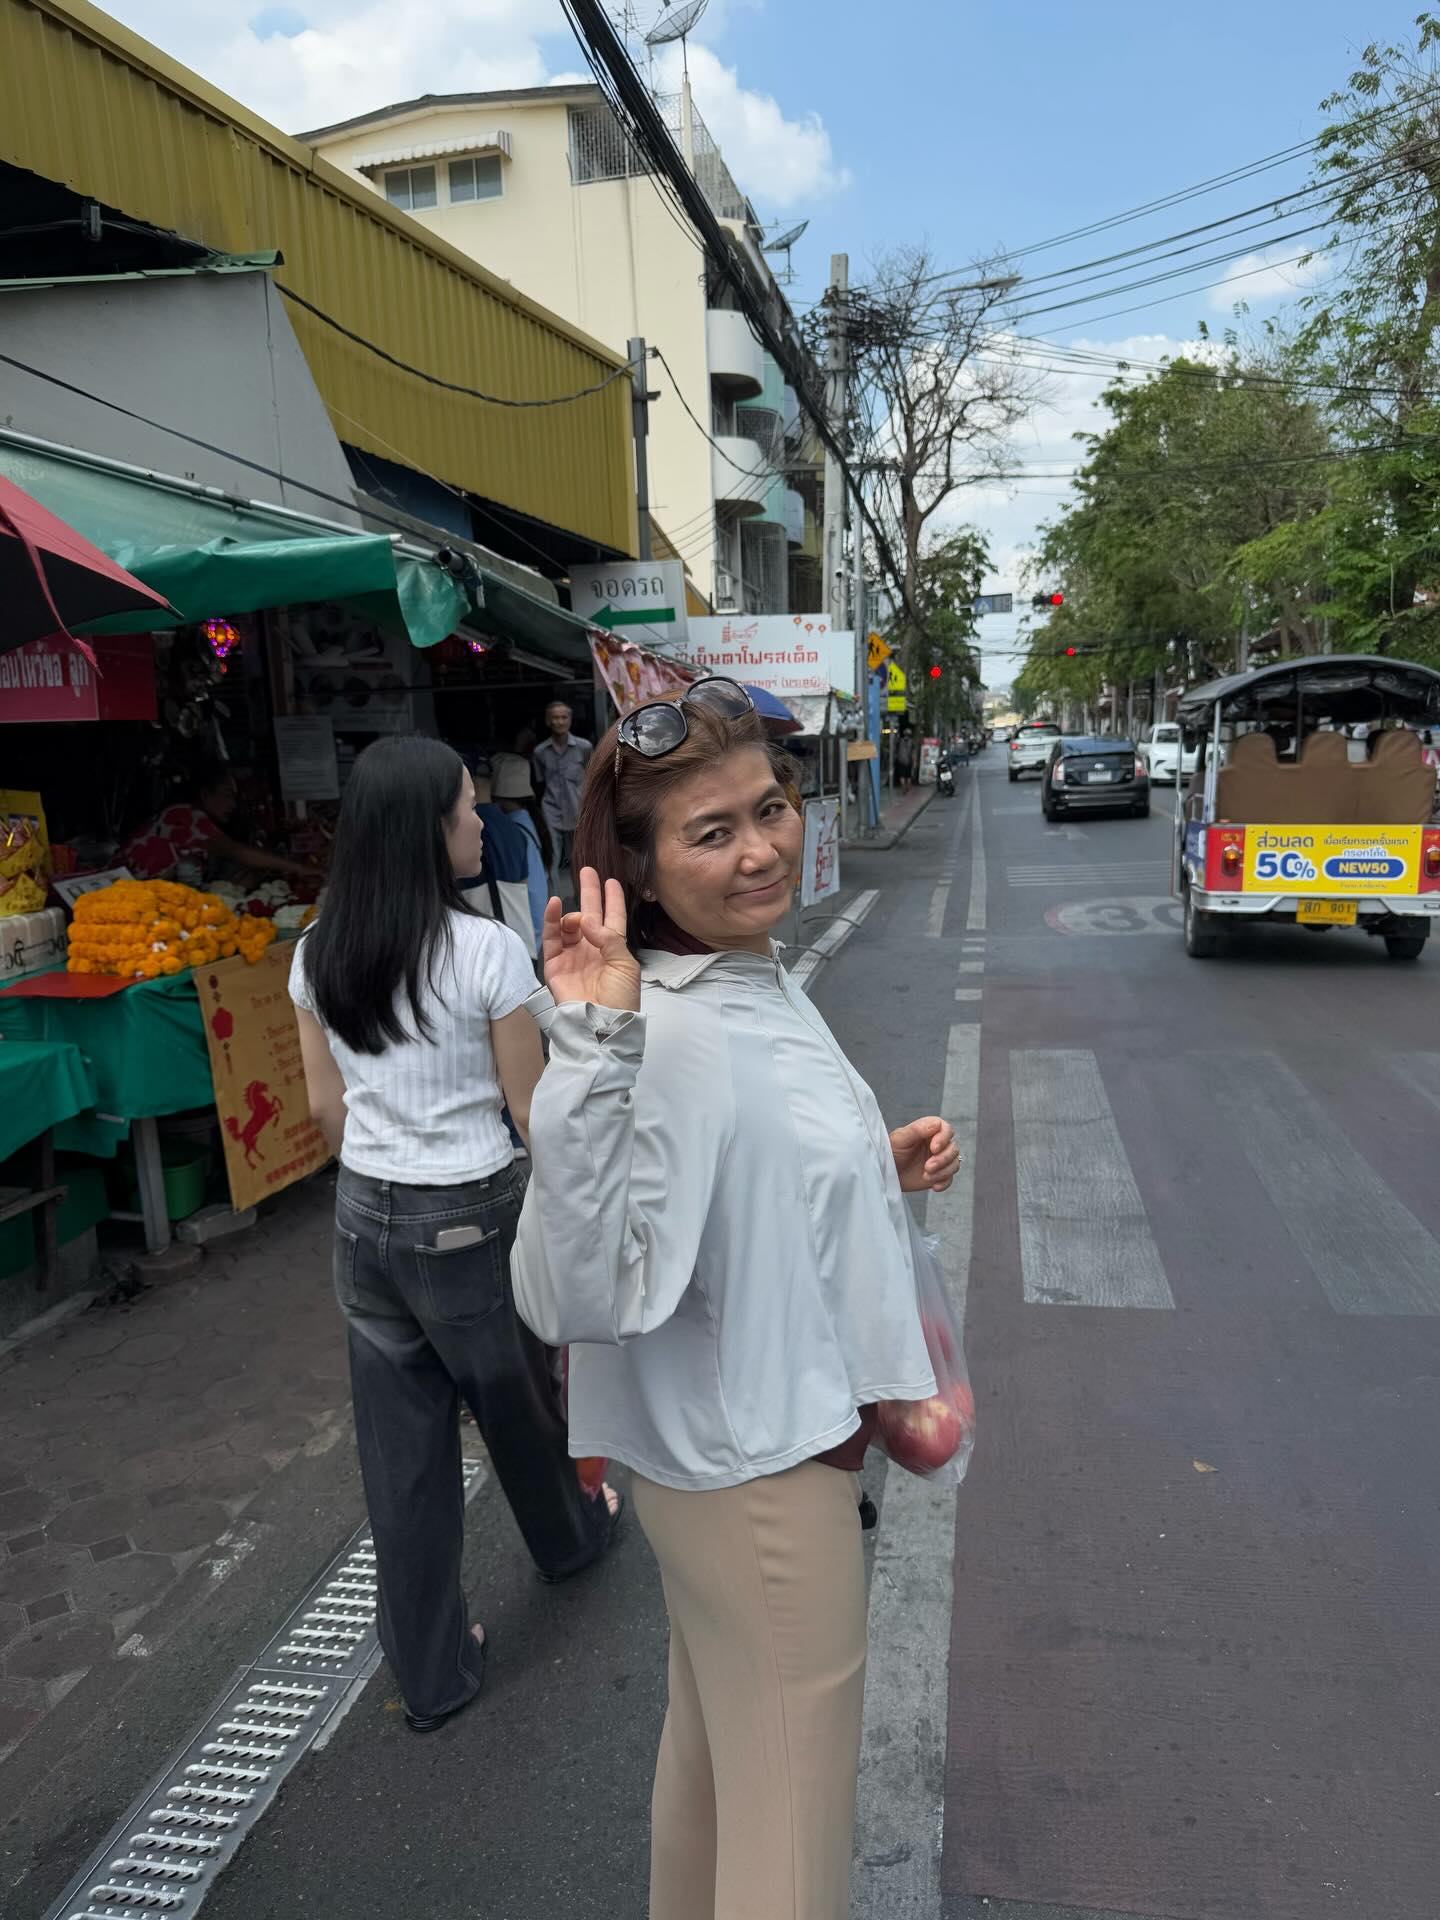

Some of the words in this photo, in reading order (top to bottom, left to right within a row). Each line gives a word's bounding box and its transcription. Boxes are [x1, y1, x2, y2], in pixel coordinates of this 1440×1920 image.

[590, 576, 664, 598] จอดรถ
[1256, 831, 1314, 848] ส่วนลด
[1256, 852, 1315, 879] 50%
[1338, 862, 1389, 874] NEW50
